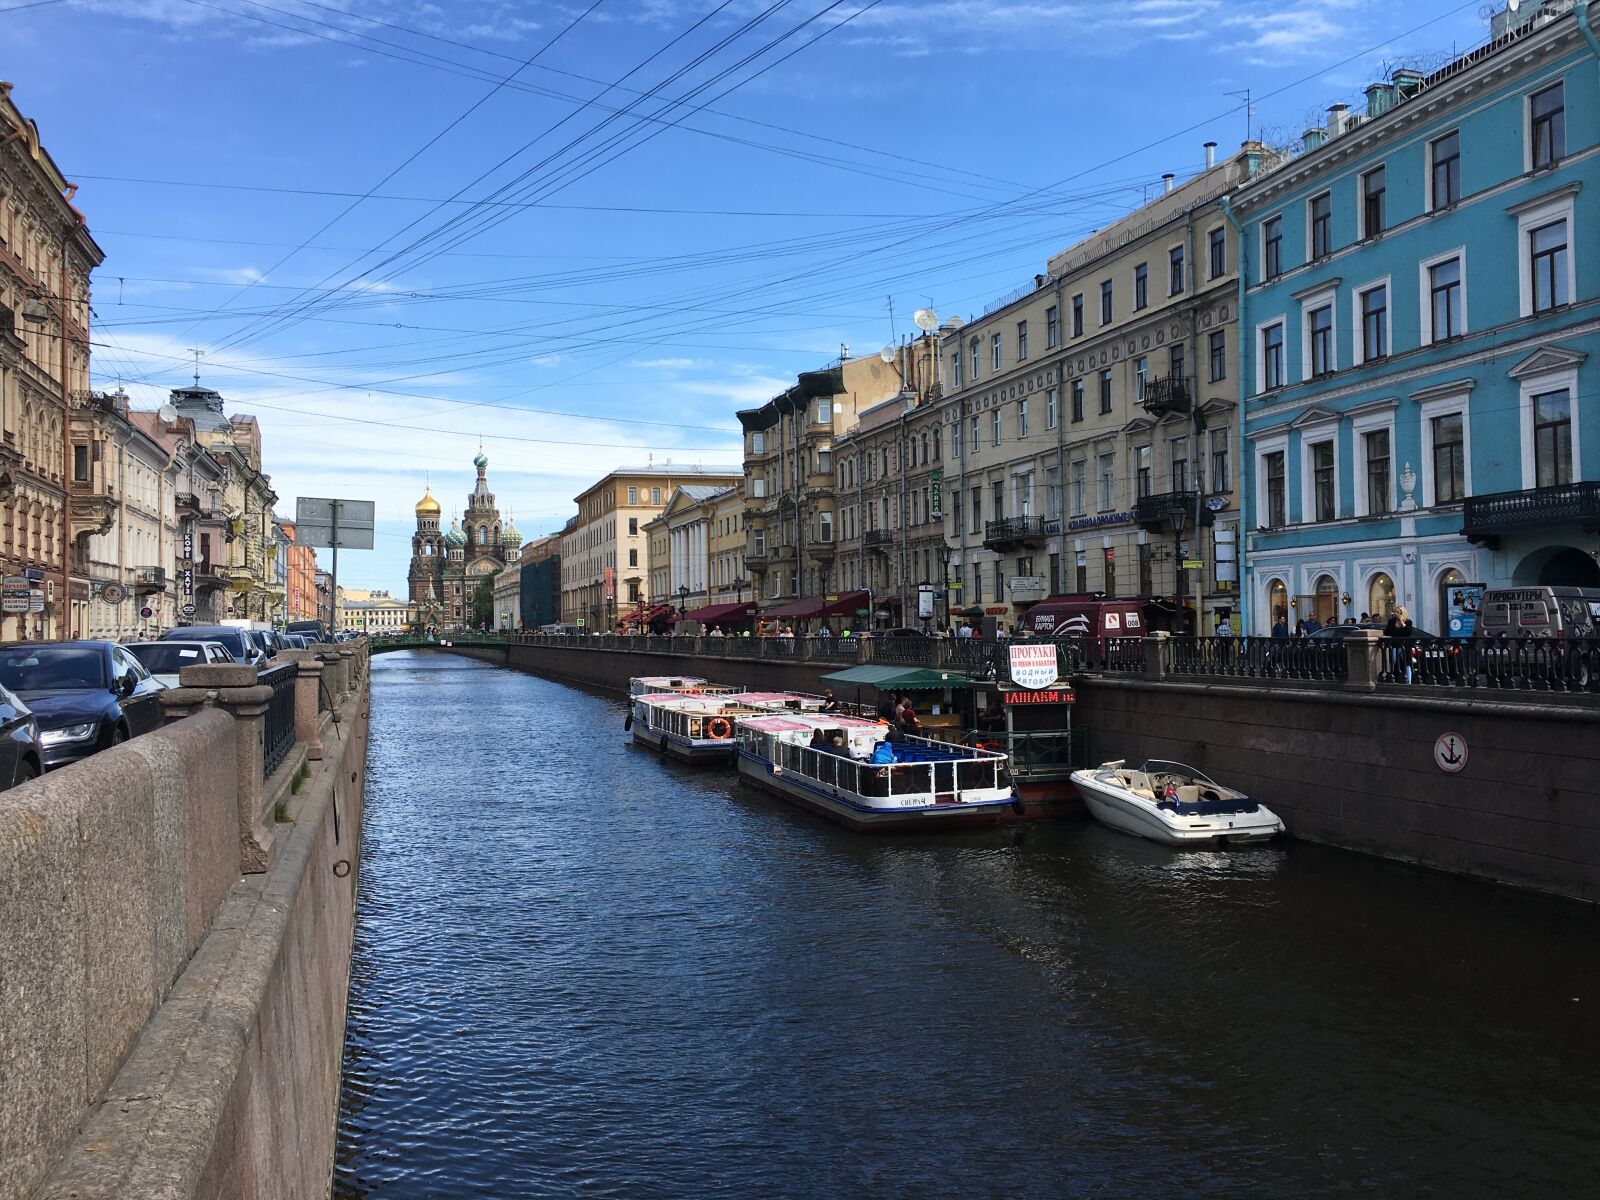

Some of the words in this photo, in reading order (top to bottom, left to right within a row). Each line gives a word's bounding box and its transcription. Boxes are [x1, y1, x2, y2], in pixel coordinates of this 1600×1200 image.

[1489, 590, 1543, 601] ГИРОСКУТЕРЫ
[1035, 614, 1055, 623] БУМАГА
[1034, 622, 1055, 631] КАРТОН
[1010, 646, 1056, 659] ПРОГУЛКИ
[1016, 675, 1055, 685] АВТОБУС
